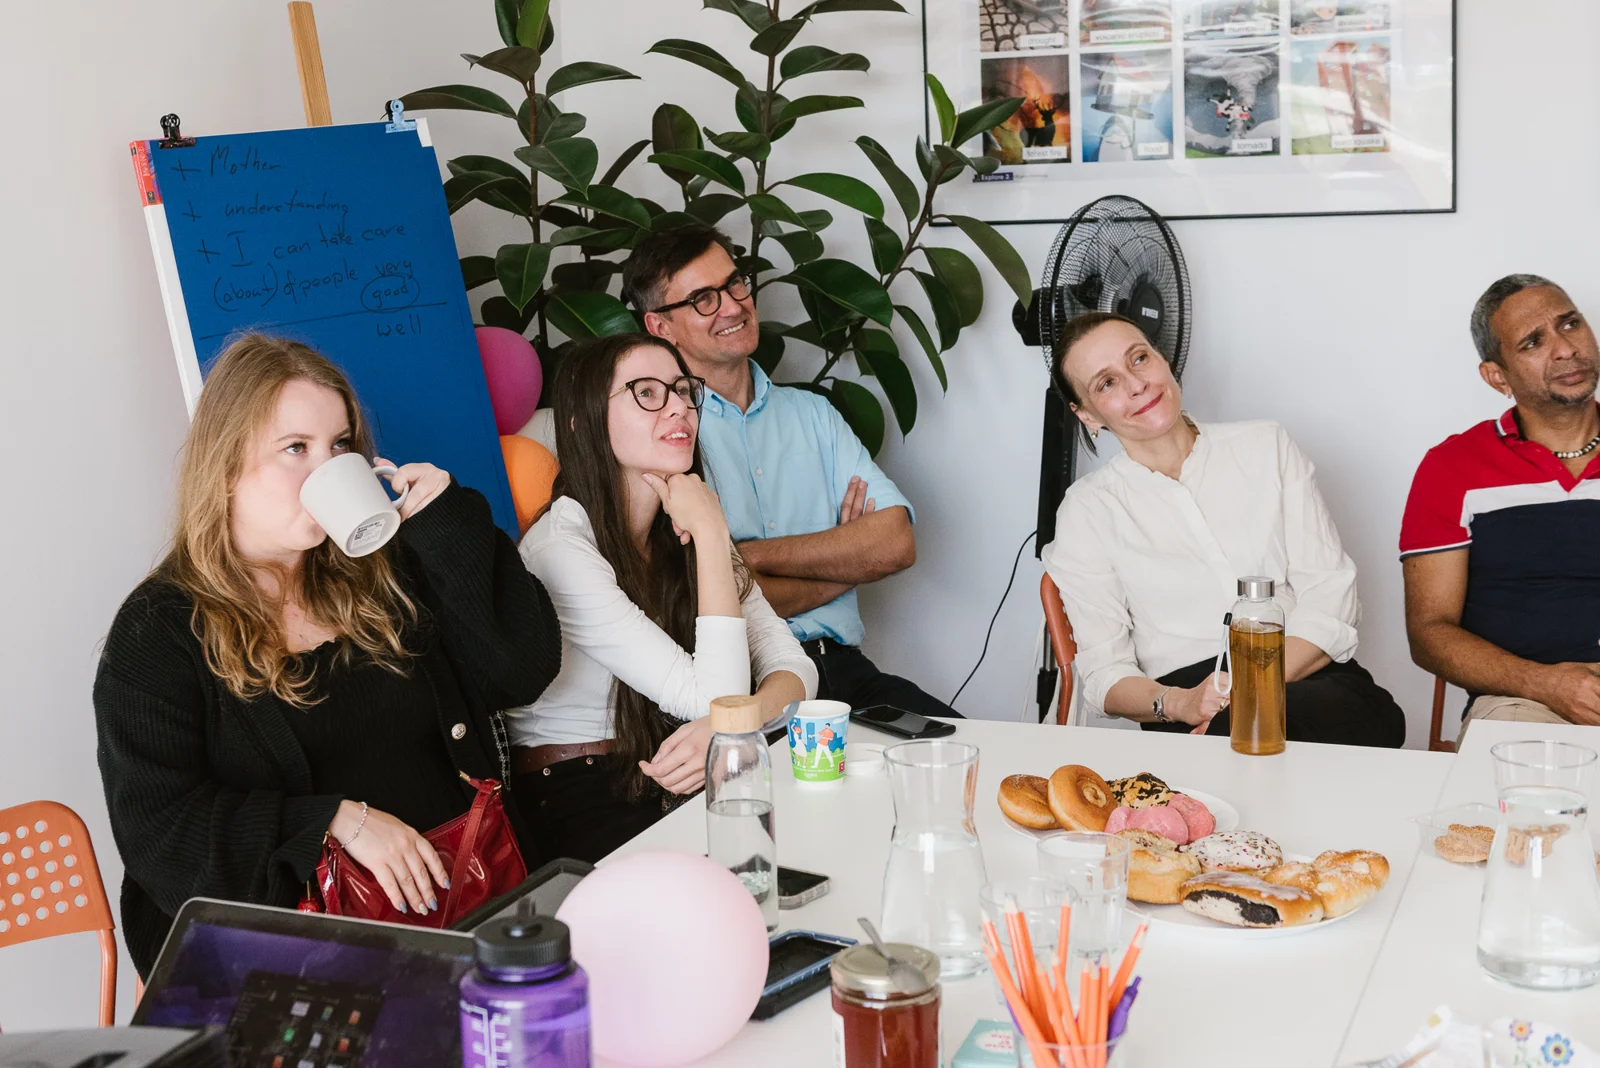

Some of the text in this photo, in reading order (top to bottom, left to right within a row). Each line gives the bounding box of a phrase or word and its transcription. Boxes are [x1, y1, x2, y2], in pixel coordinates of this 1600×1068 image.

[1237, 141, 1268, 150] tornado
[211, 144, 281, 177] Mother
[1005, 173, 1011, 181] 2
[225, 190, 348, 235] understanding
[273, 242, 311, 259] can
[318, 223, 353, 248] take
[361, 224, 406, 241] care
[375, 260, 413, 279] very
[372, 276, 409, 309] good
[376, 313, 422, 337] well
